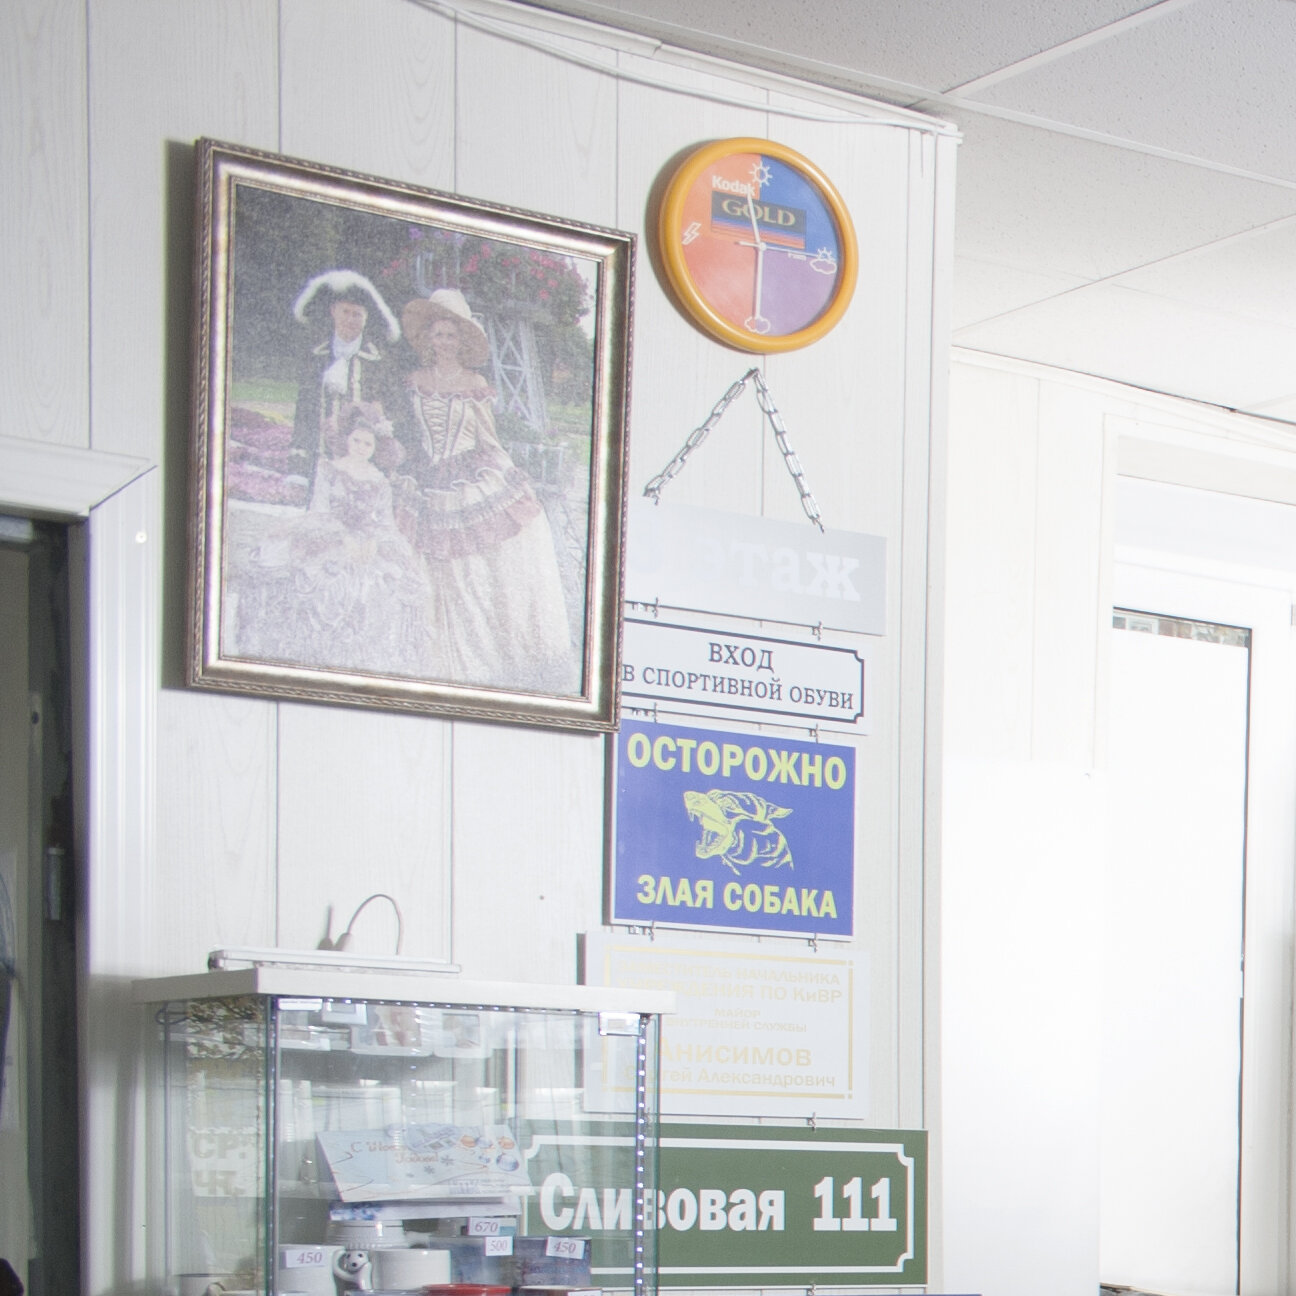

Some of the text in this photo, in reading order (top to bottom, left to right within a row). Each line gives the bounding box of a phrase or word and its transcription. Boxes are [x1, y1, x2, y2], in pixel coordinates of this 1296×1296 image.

[712, 175, 755, 196] Kodak
[722, 198, 796, 226] GOLD
[709, 642, 775, 674] ВХОД
[642, 665, 783, 702] СПОРТИВНОЙ
[789, 685, 854, 711] ОБУВИ
[627, 733, 848, 790] ОСТОРОЖНО
[636, 874, 838, 919] ЗЛАЯ СОБАКА
[736, 968, 840, 985] НАЧАЛЬНИКА
[760, 985, 786, 1001] ПО
[714, 1007, 761, 1018] МАЙОР
[753, 1020, 807, 1033] СЛУЖБЫ
[698, 1070, 836, 1088] Александрович
[538, 1172, 898, 1232] Сливовая 111
[474, 1220, 498, 1234] 670
[489, 1238, 508, 1253] 500
[553, 1241, 577, 1255] 450
[296, 1251, 323, 1265] 450
